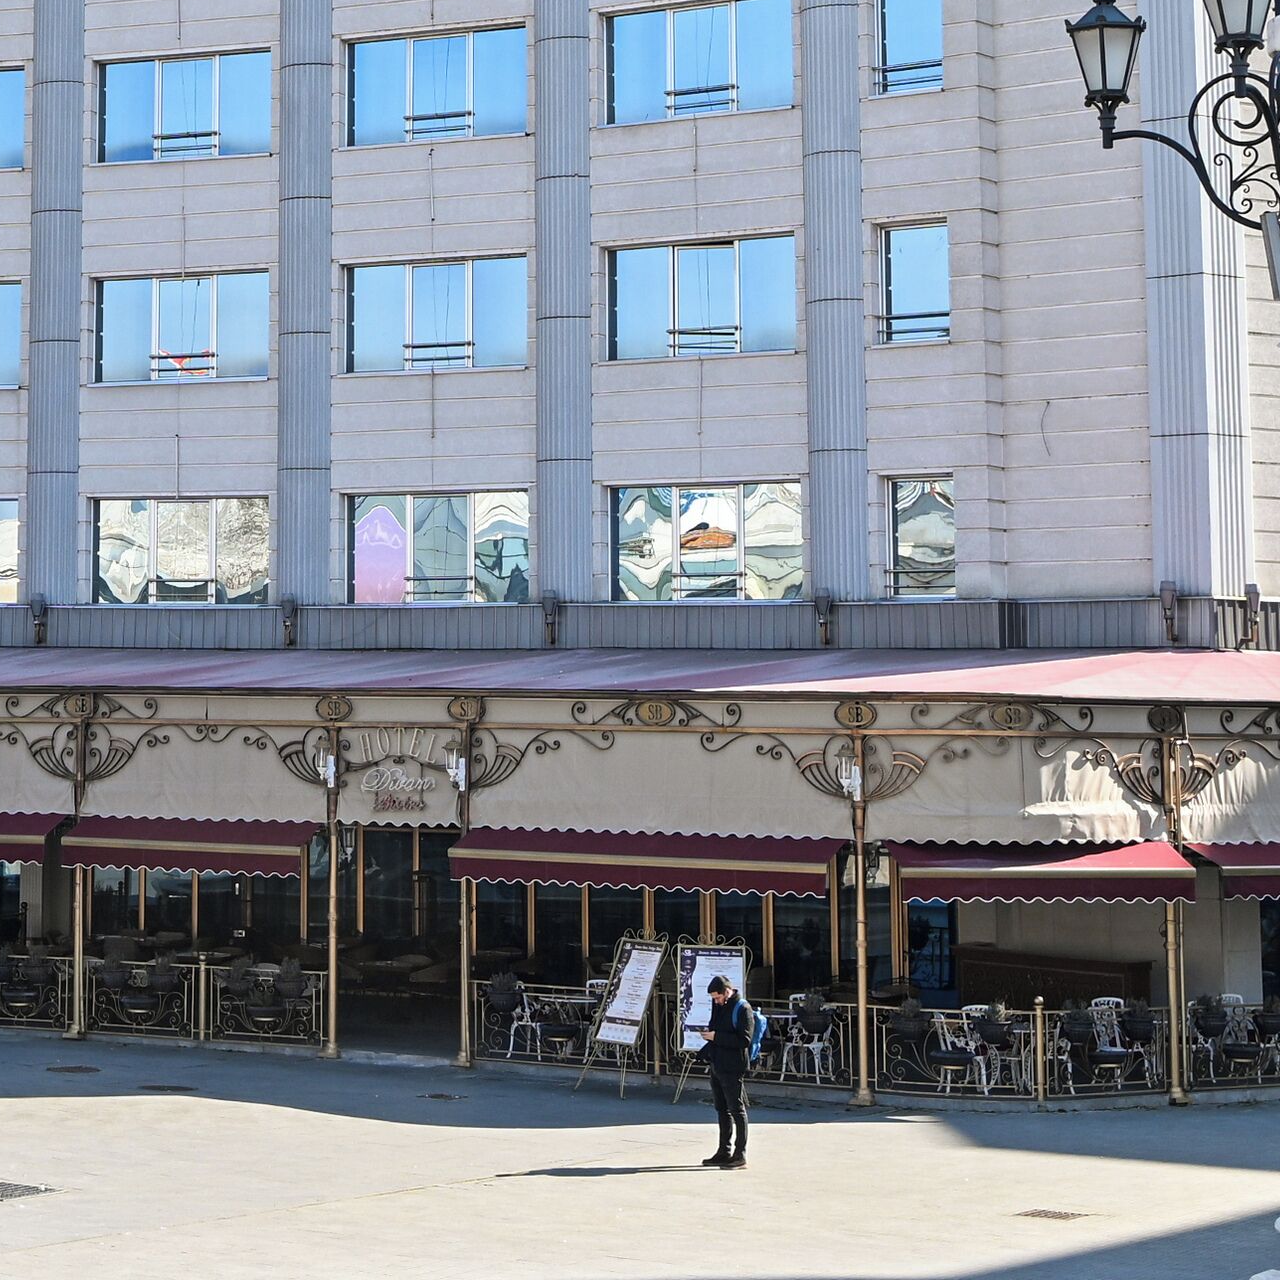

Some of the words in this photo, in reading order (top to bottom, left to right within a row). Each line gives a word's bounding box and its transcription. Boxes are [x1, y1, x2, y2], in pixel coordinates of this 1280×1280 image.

[74, 698, 88, 712] SB
[327, 701, 341, 716] SB
[648, 704, 662, 720] SB
[848, 706, 863, 723] SB
[359, 727, 437, 764] HOTEL
[360, 767, 436, 793] Divan
